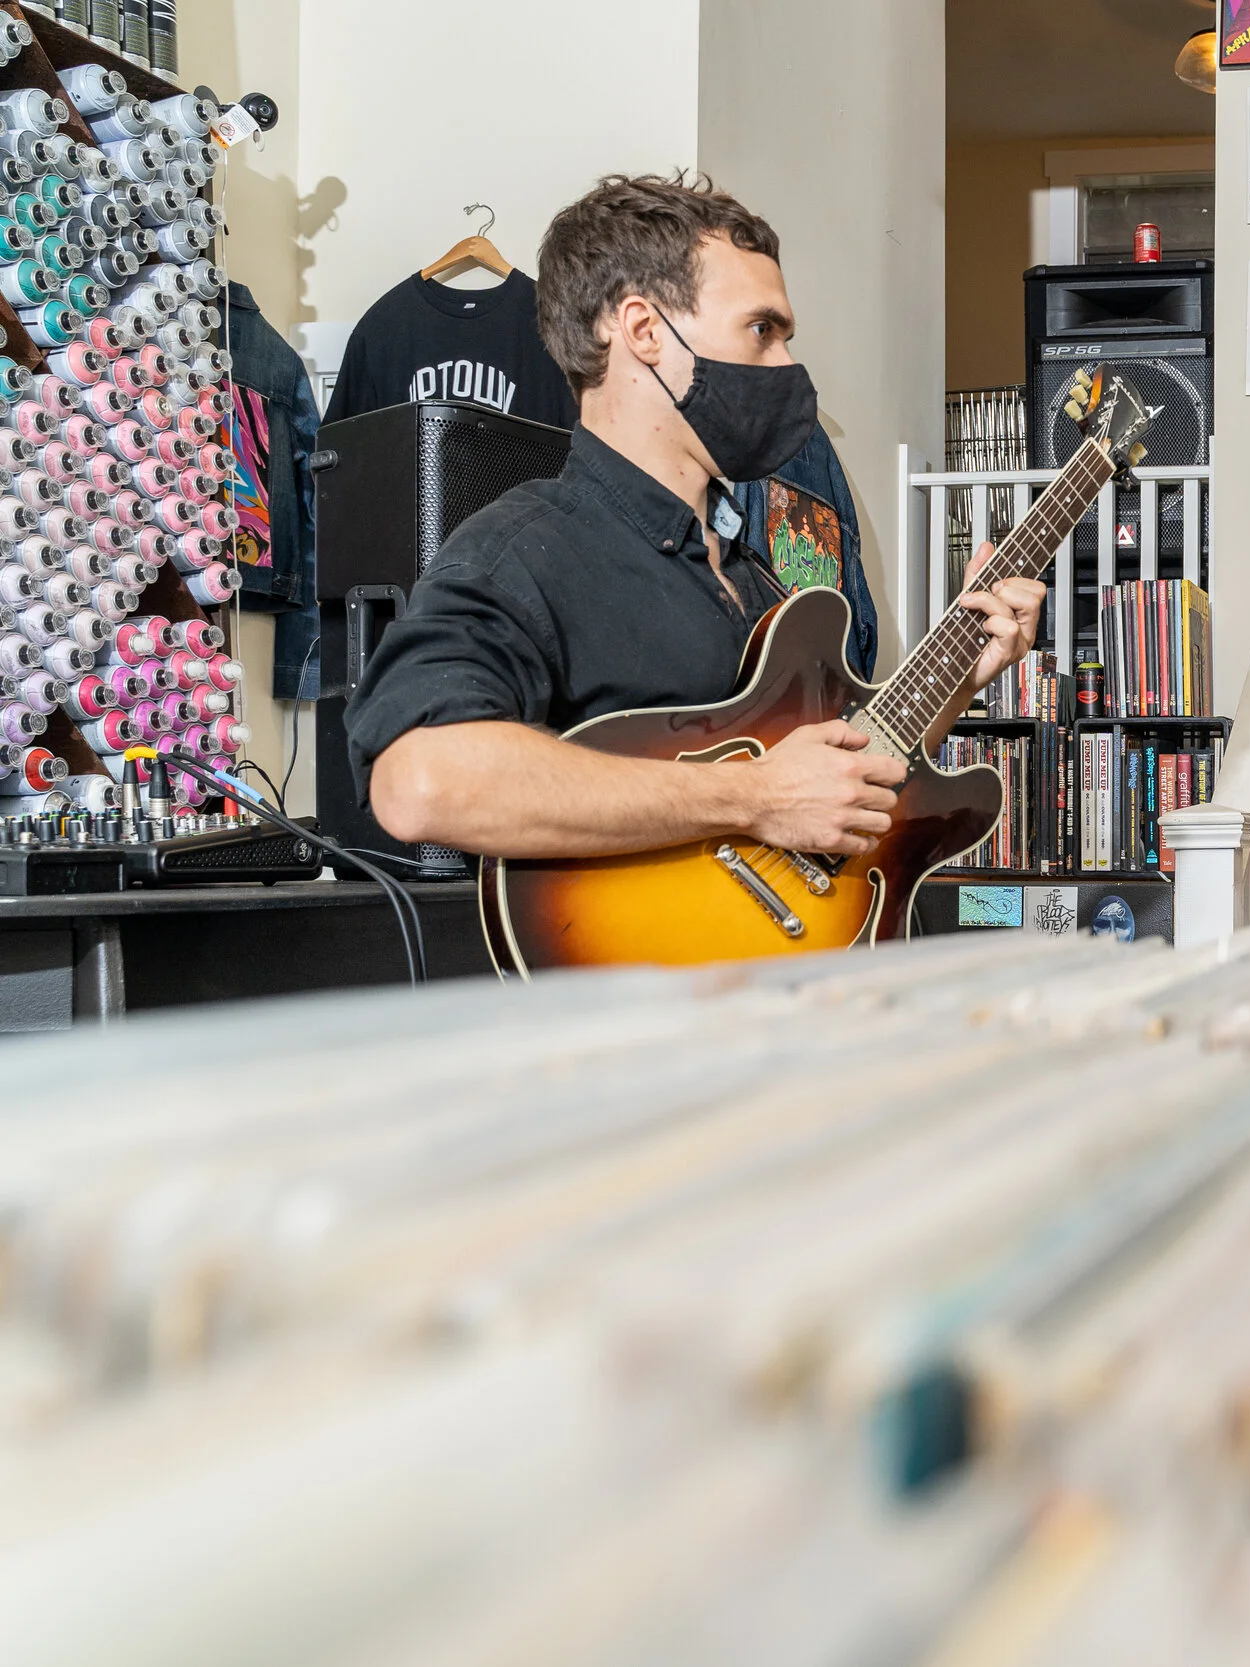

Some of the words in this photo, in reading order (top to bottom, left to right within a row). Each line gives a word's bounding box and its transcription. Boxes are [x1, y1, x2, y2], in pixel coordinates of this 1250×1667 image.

[1074, 345, 1102, 354] 5G
[1084, 765, 1091, 778] ME
[1100, 765, 1107, 778] ME
[1084, 780, 1091, 791] UP
[1100, 780, 1107, 791] UP
[1178, 772, 1190, 808] graffiti
